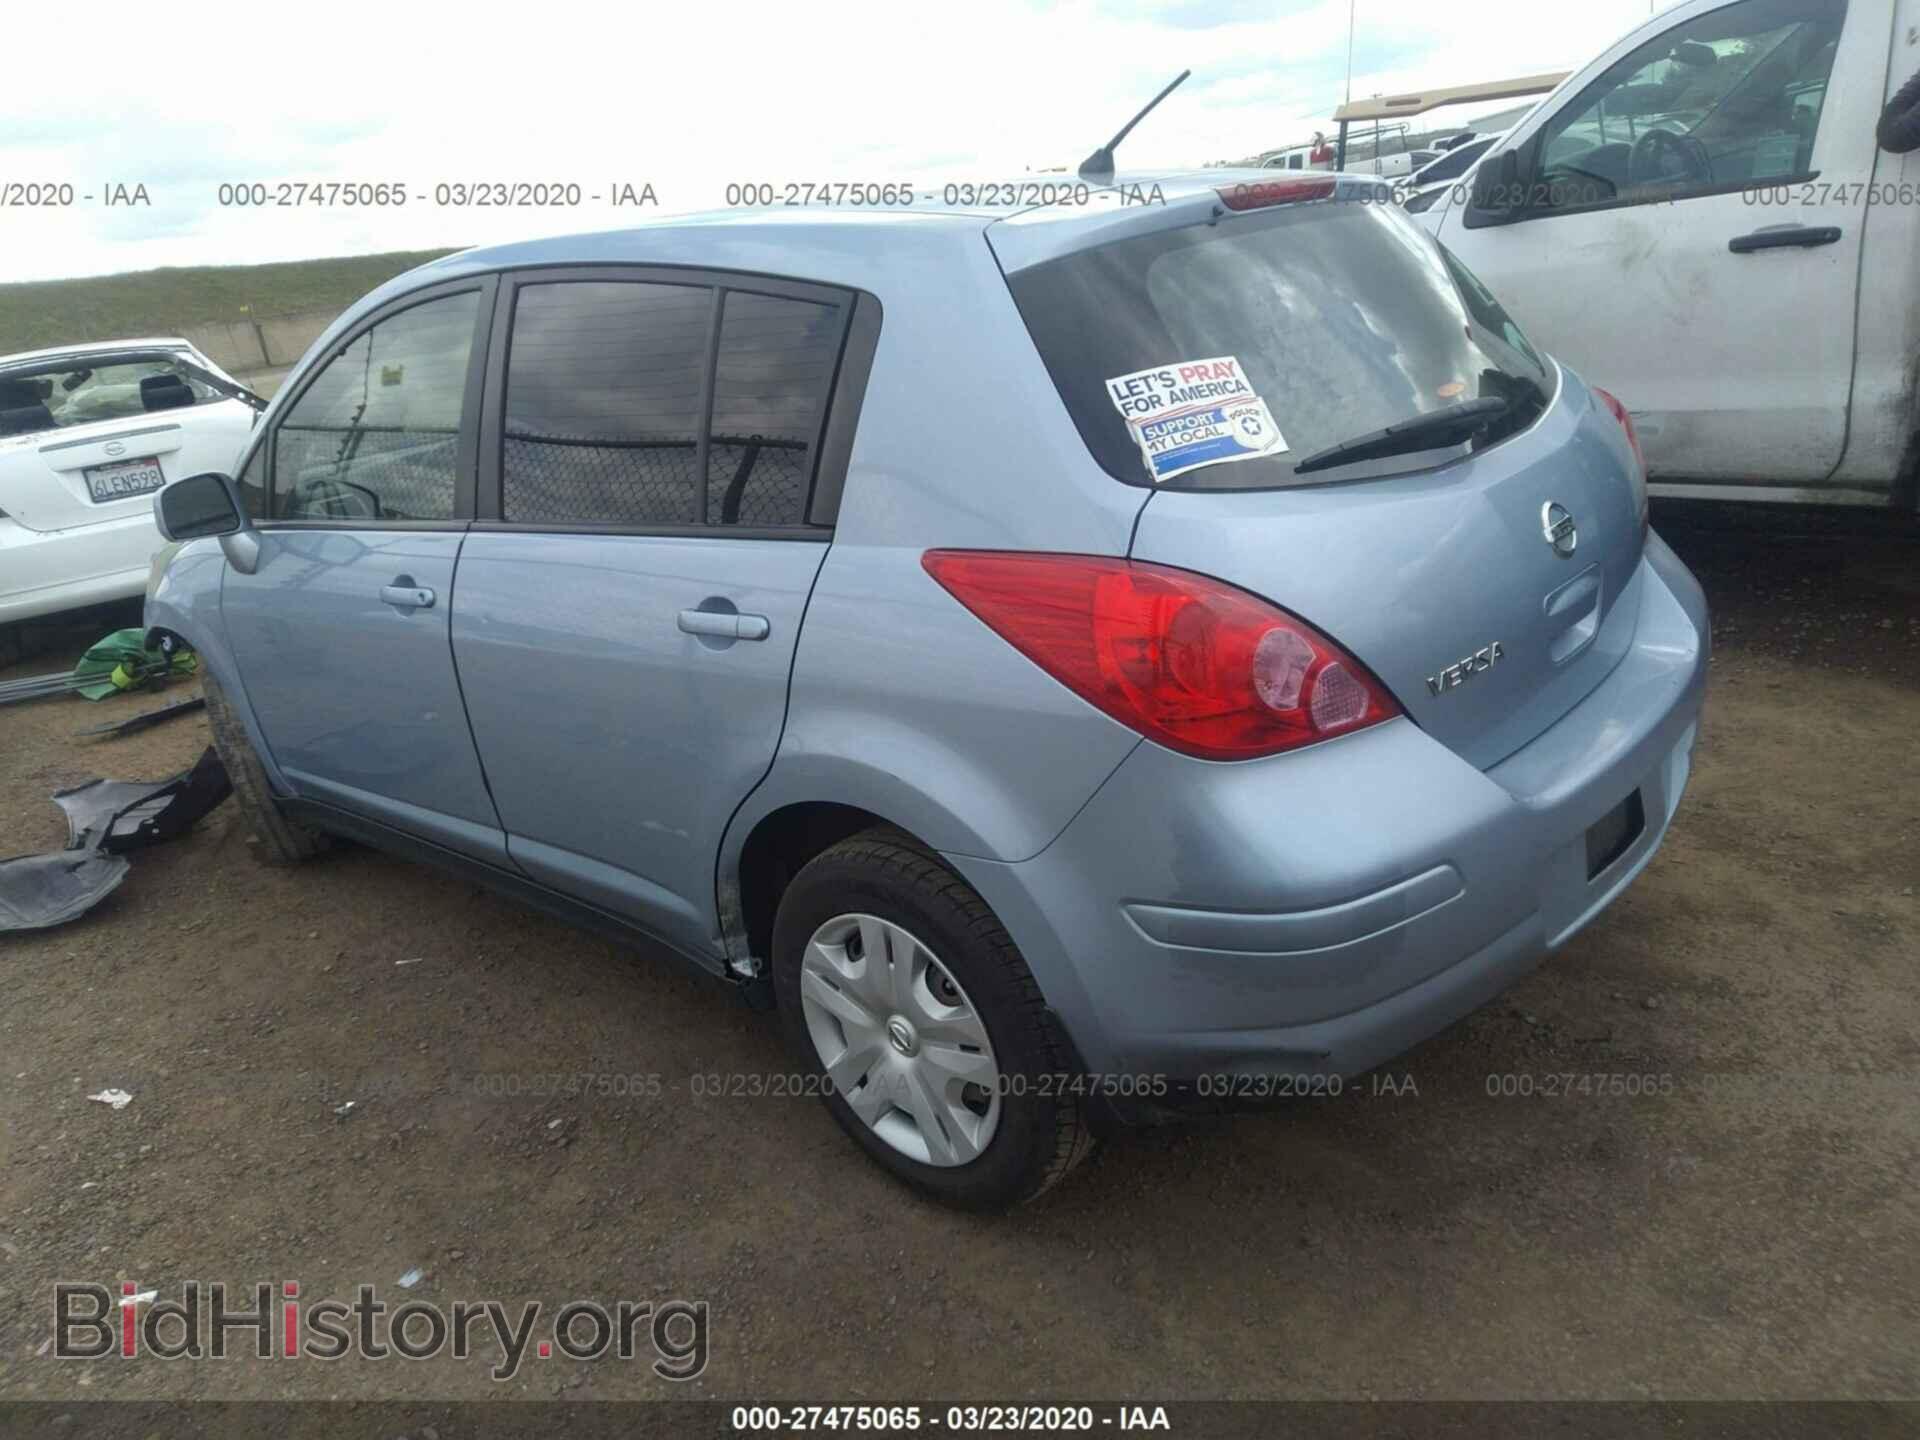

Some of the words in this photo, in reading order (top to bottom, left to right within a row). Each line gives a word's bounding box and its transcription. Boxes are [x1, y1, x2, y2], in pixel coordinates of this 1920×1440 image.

[1112, 371, 1177, 401] LET'S
[1178, 361, 1236, 384] PRAY
[1121, 394, 1163, 416] FOR
[1170, 379, 1248, 404] AMERICA
[1145, 413, 1215, 440] SUPPORT
[1171, 426, 1224, 446] LOCAL
[95, 470, 160, 497] 6LEN598
[1426, 641, 1504, 696] VERSA
